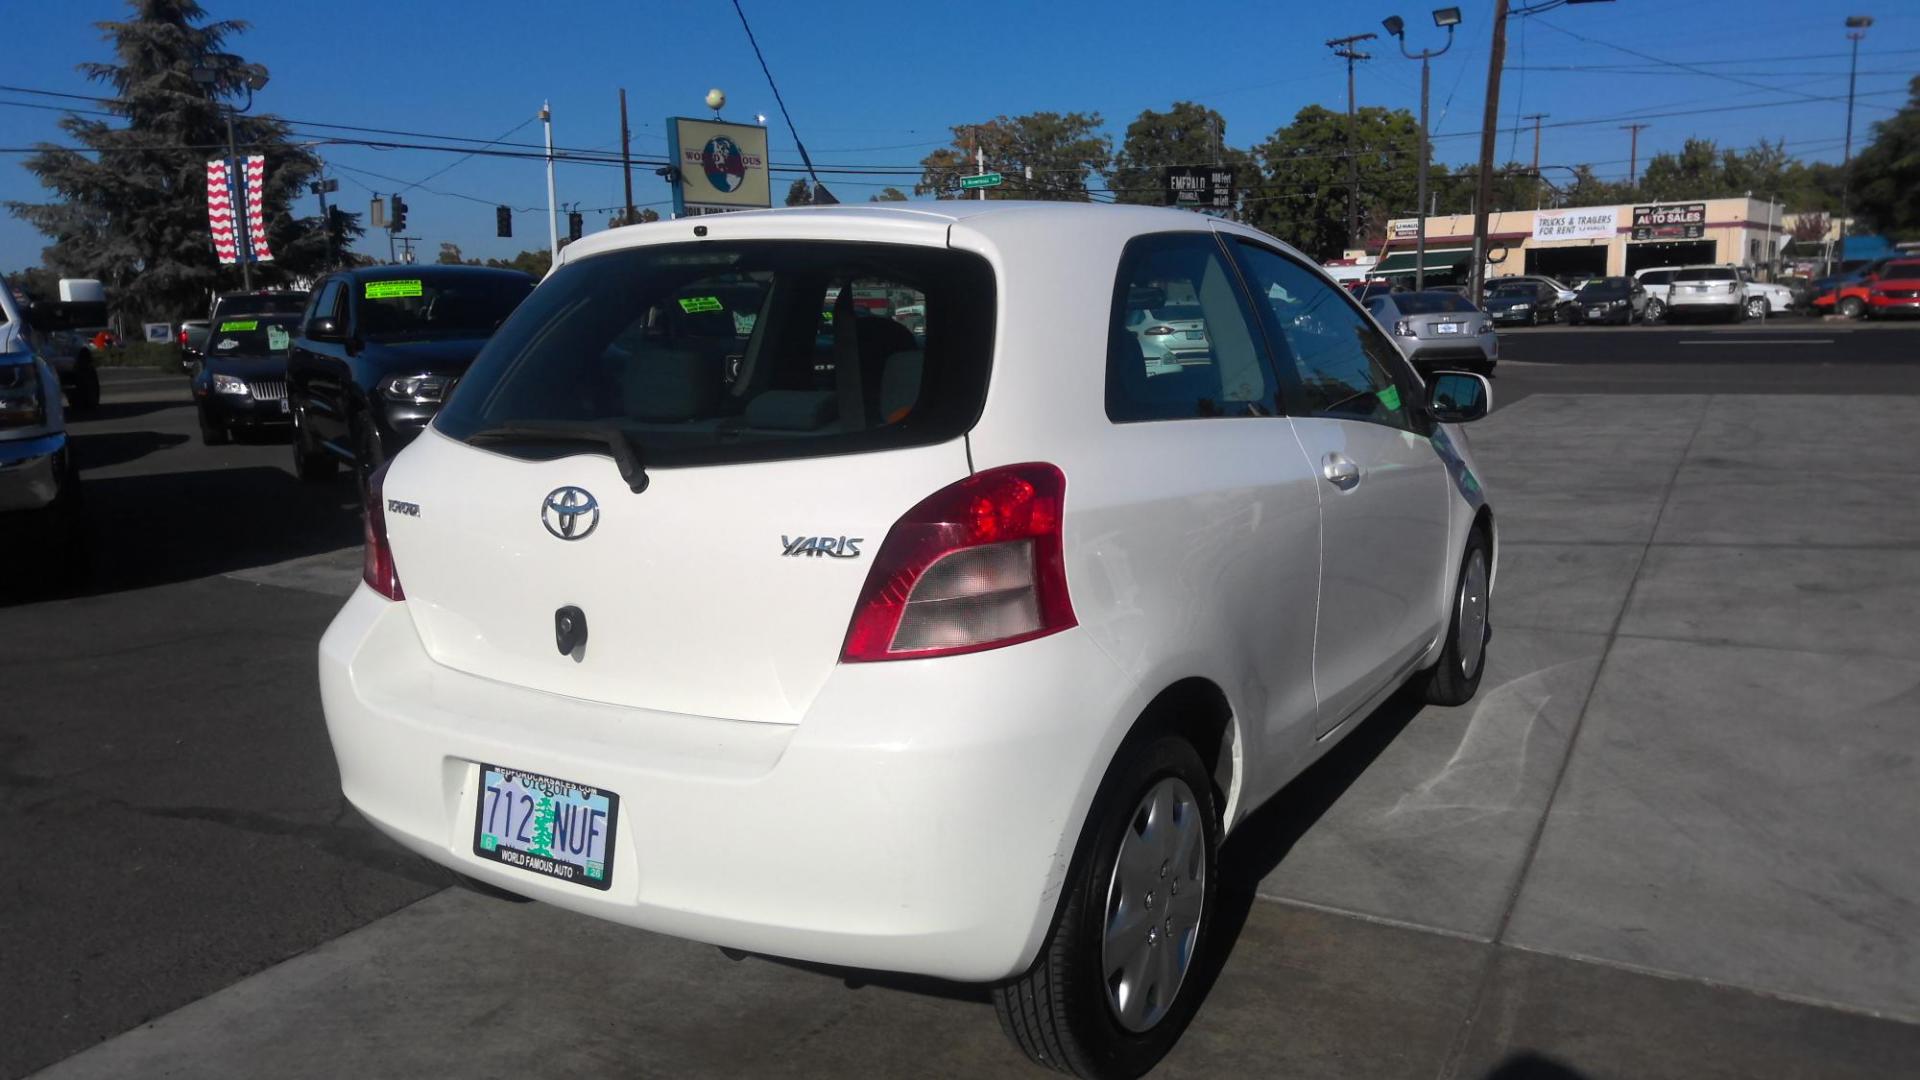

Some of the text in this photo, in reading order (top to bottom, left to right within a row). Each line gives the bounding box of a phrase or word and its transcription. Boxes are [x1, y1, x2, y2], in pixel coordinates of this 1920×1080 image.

[1171, 175, 1206, 190] EMERALD
[1539, 215, 1612, 226] TRUCKS & TRAILERS
[1638, 212, 1701, 225] AUTO SALES
[1539, 226, 1553, 235] FOR
[1556, 225, 1576, 235] RENT
[388, 499, 421, 517] TOYOTA
[781, 535, 864, 558] YARIS
[521, 778, 570, 798] Oregon
[487, 786, 606, 858] 712 NUF
[501, 850, 525, 866] WORLD
[525, 856, 553, 873] FAMOUS
[554, 862, 573, 878] AUTO
